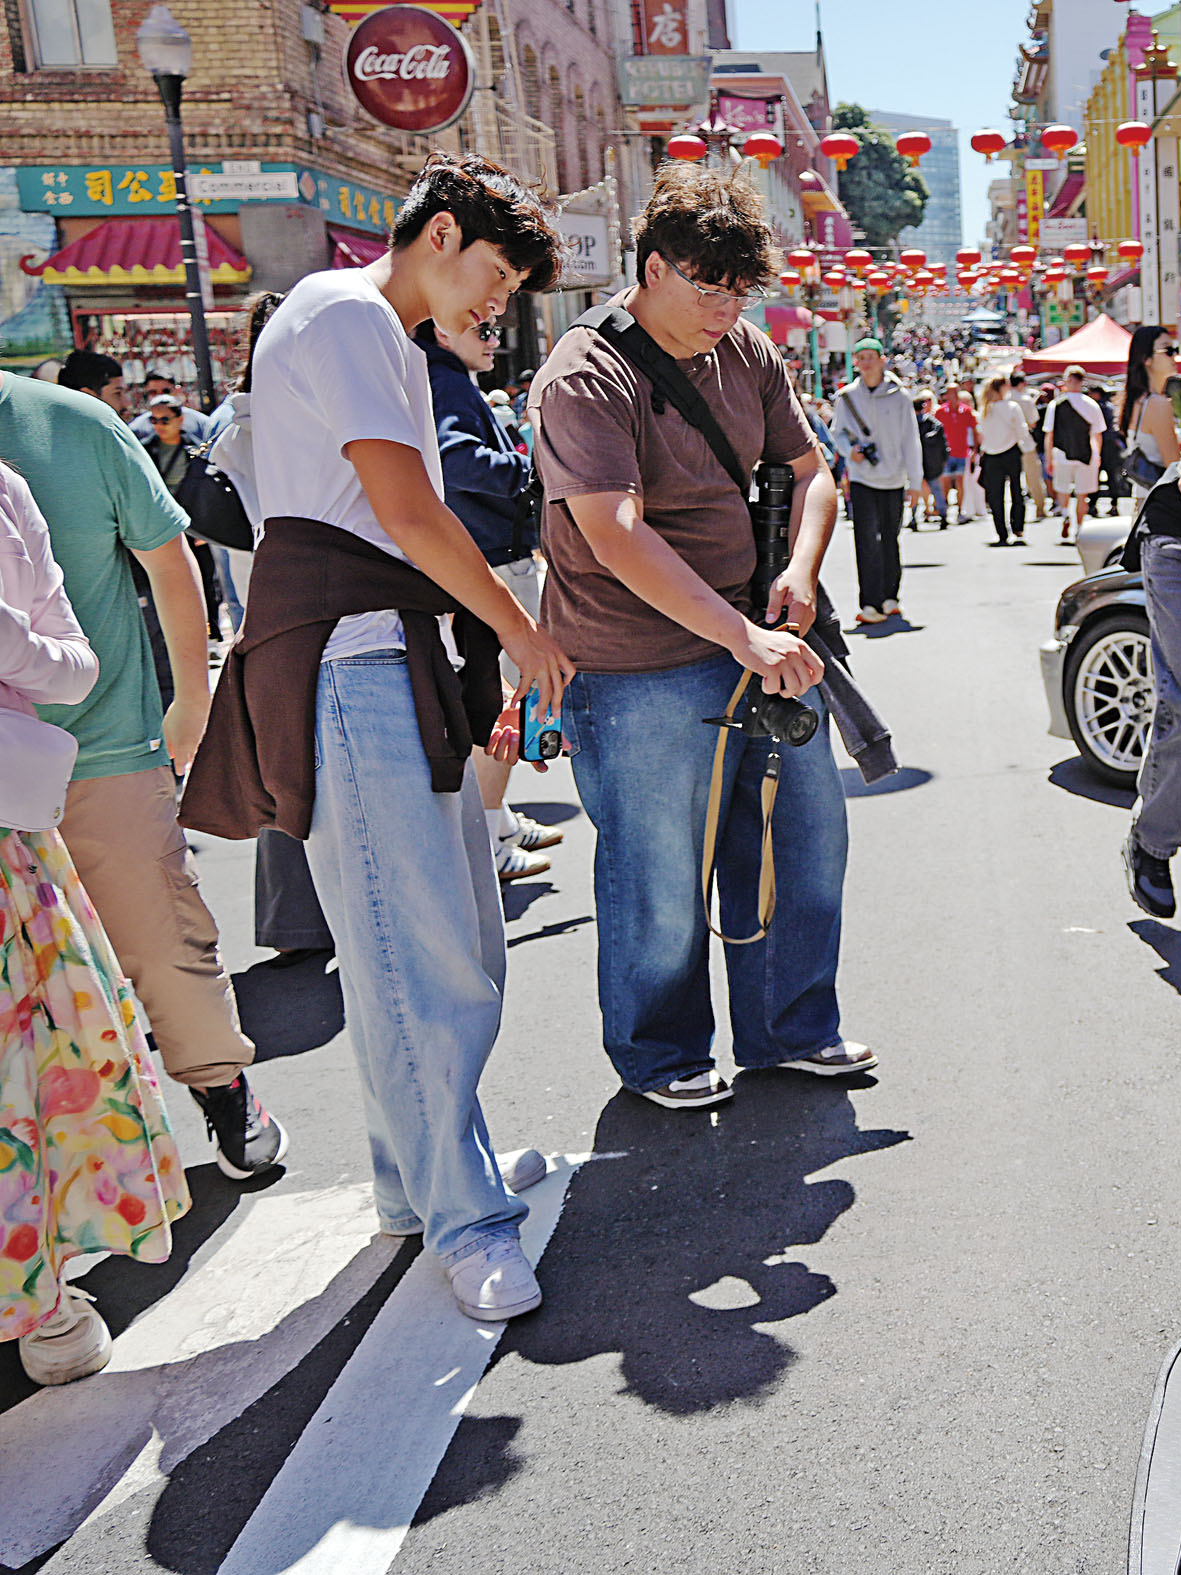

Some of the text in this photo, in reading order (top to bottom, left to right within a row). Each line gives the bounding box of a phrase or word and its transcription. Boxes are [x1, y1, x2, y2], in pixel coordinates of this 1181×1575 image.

[648, 3, 682, 47] 店
[354, 44, 451, 81] Coca-Cola
[629, 81, 695, 98] HOTEL
